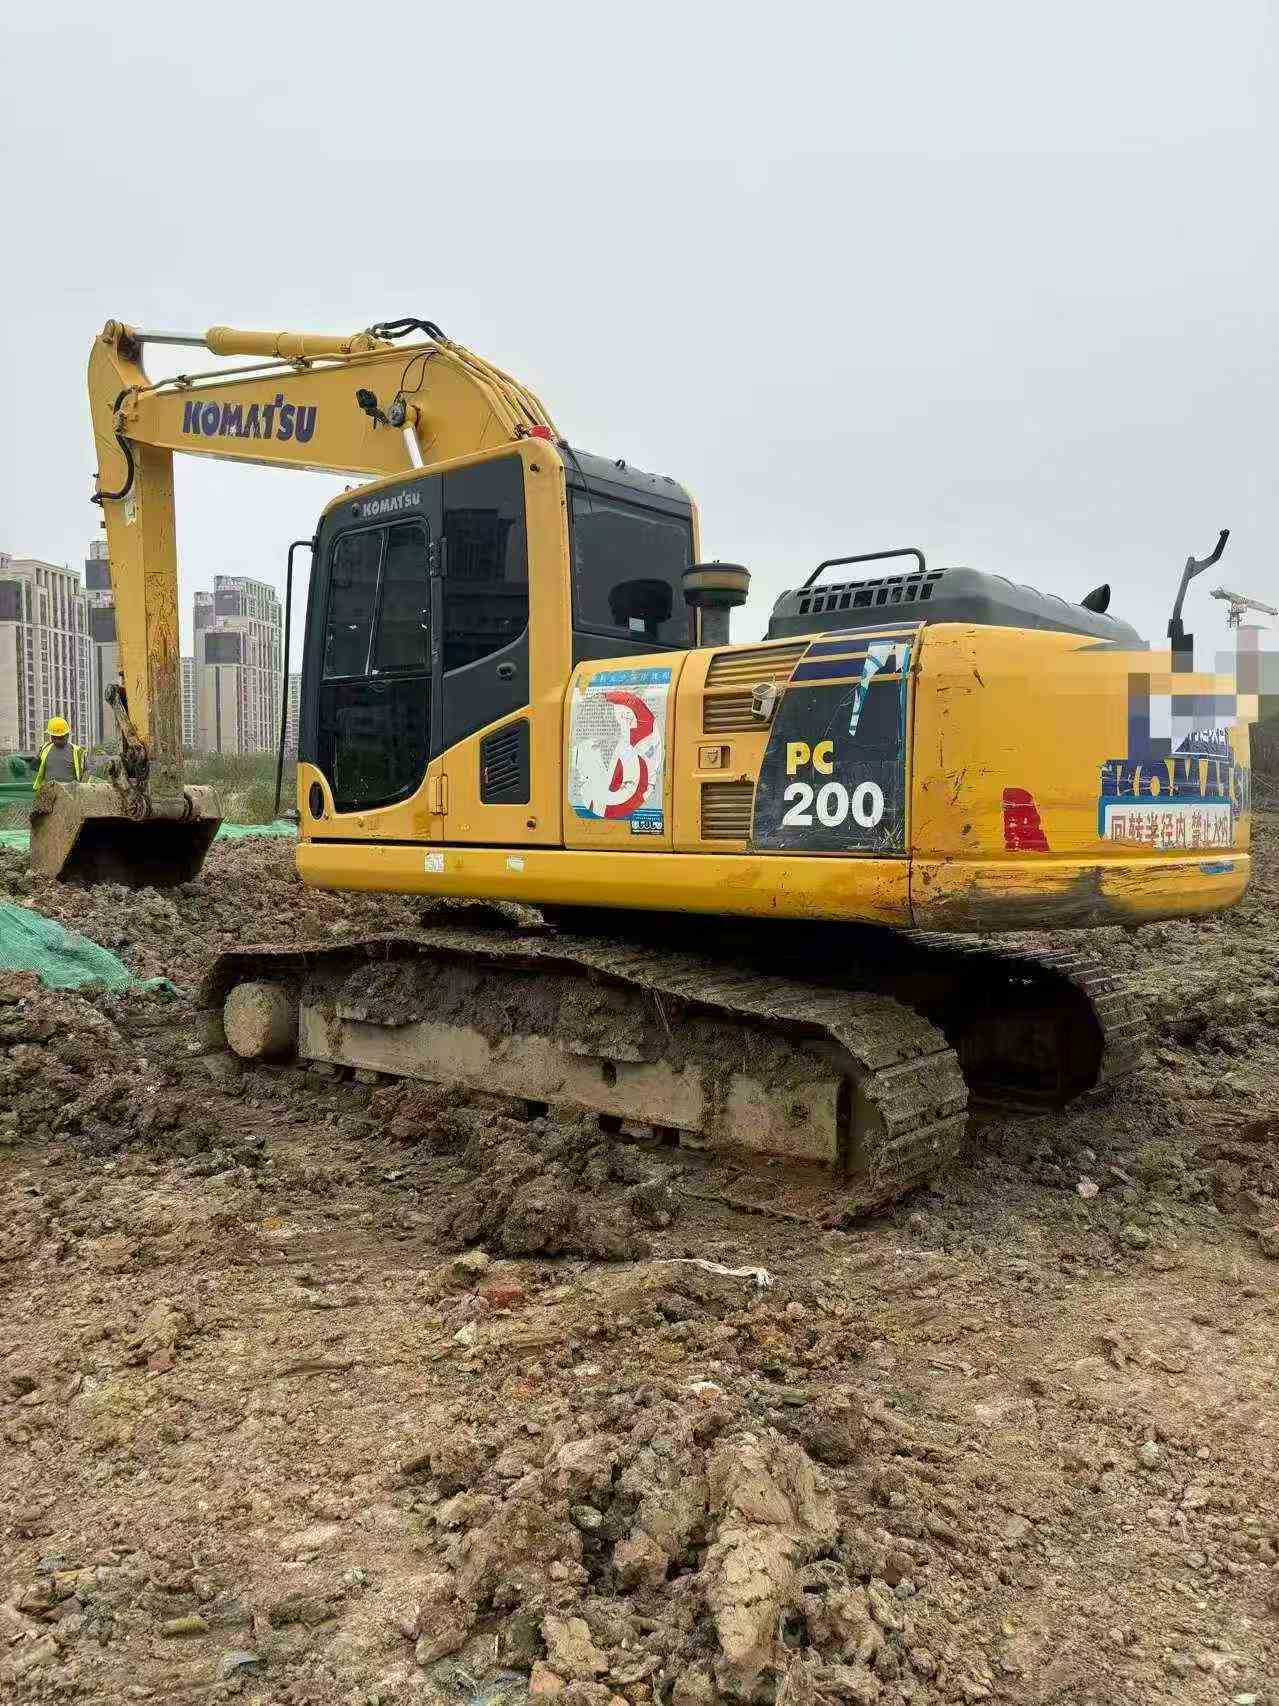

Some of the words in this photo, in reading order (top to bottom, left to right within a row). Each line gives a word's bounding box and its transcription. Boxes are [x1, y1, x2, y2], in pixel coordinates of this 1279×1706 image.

[182, 393, 318, 444] KOMATSU
[363, 489, 420, 517] KOMATSU
[786, 740, 834, 775] PC
[782, 781, 885, 828] 200
